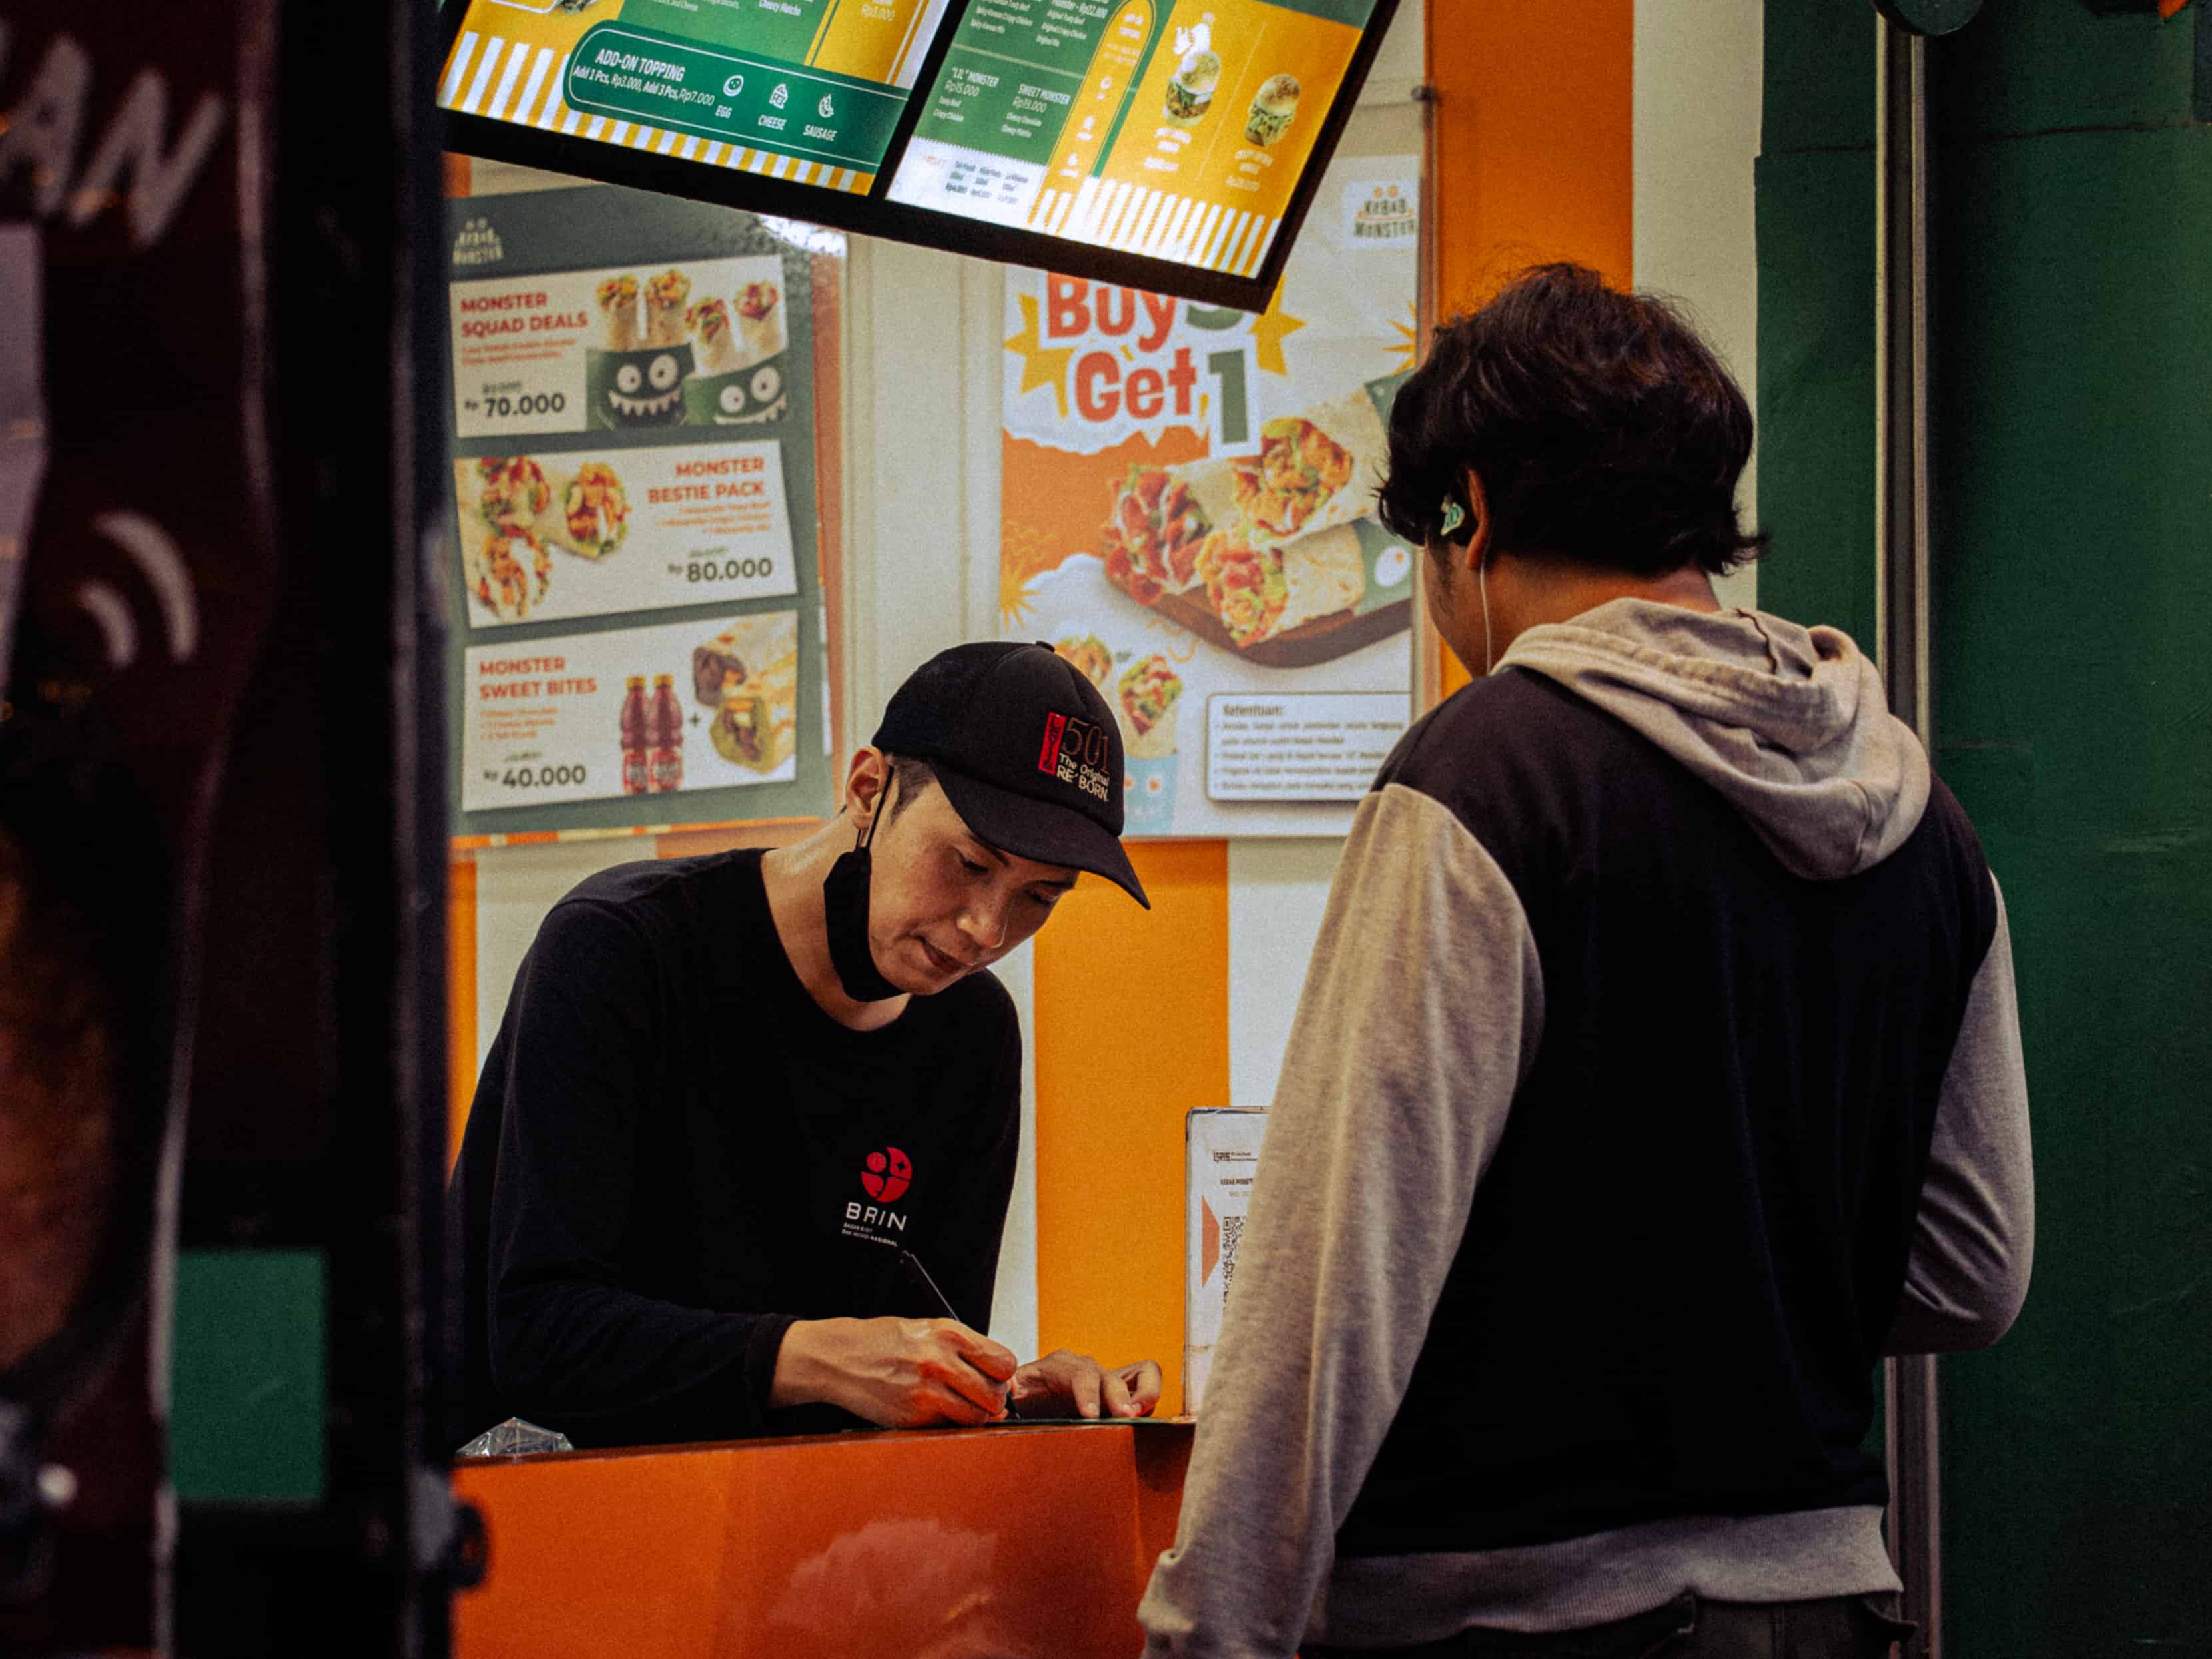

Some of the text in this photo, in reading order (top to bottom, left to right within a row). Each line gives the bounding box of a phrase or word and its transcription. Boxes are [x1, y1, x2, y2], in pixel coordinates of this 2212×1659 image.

[595, 49, 685, 81] ADD-ON TOPPING
[573, 65, 588, 79] Add
[589, 69, 595, 80] 1
[642, 81, 661, 95] Add
[659, 85, 665, 95] 3
[968, 71, 999, 88] MONSTER
[1018, 83, 1071, 105] SWEET MONSTER
[715, 105, 732, 118] EGG
[757, 115, 787, 130] CHEESE
[803, 125, 837, 141] SAUSAGE
[460, 292, 548, 313] MONSTER
[1047, 272, 1176, 353] Buy
[462, 312, 588, 339] SQUAD DEALS
[485, 392, 565, 417] 70.000
[1075, 347, 1249, 444] Get 1
[675, 456, 764, 477] MONSTER
[647, 480, 764, 504] BESTIE PACK
[687, 557, 773, 583] 80.000
[478, 655, 566, 677] MONSTER
[479, 677, 597, 700] SWEET BITES
[1062, 717, 1109, 773] 501
[502, 764, 586, 787] 40.000
[1059, 753, 1110, 787] The Original
[846, 1201, 907, 1231] BRIN
